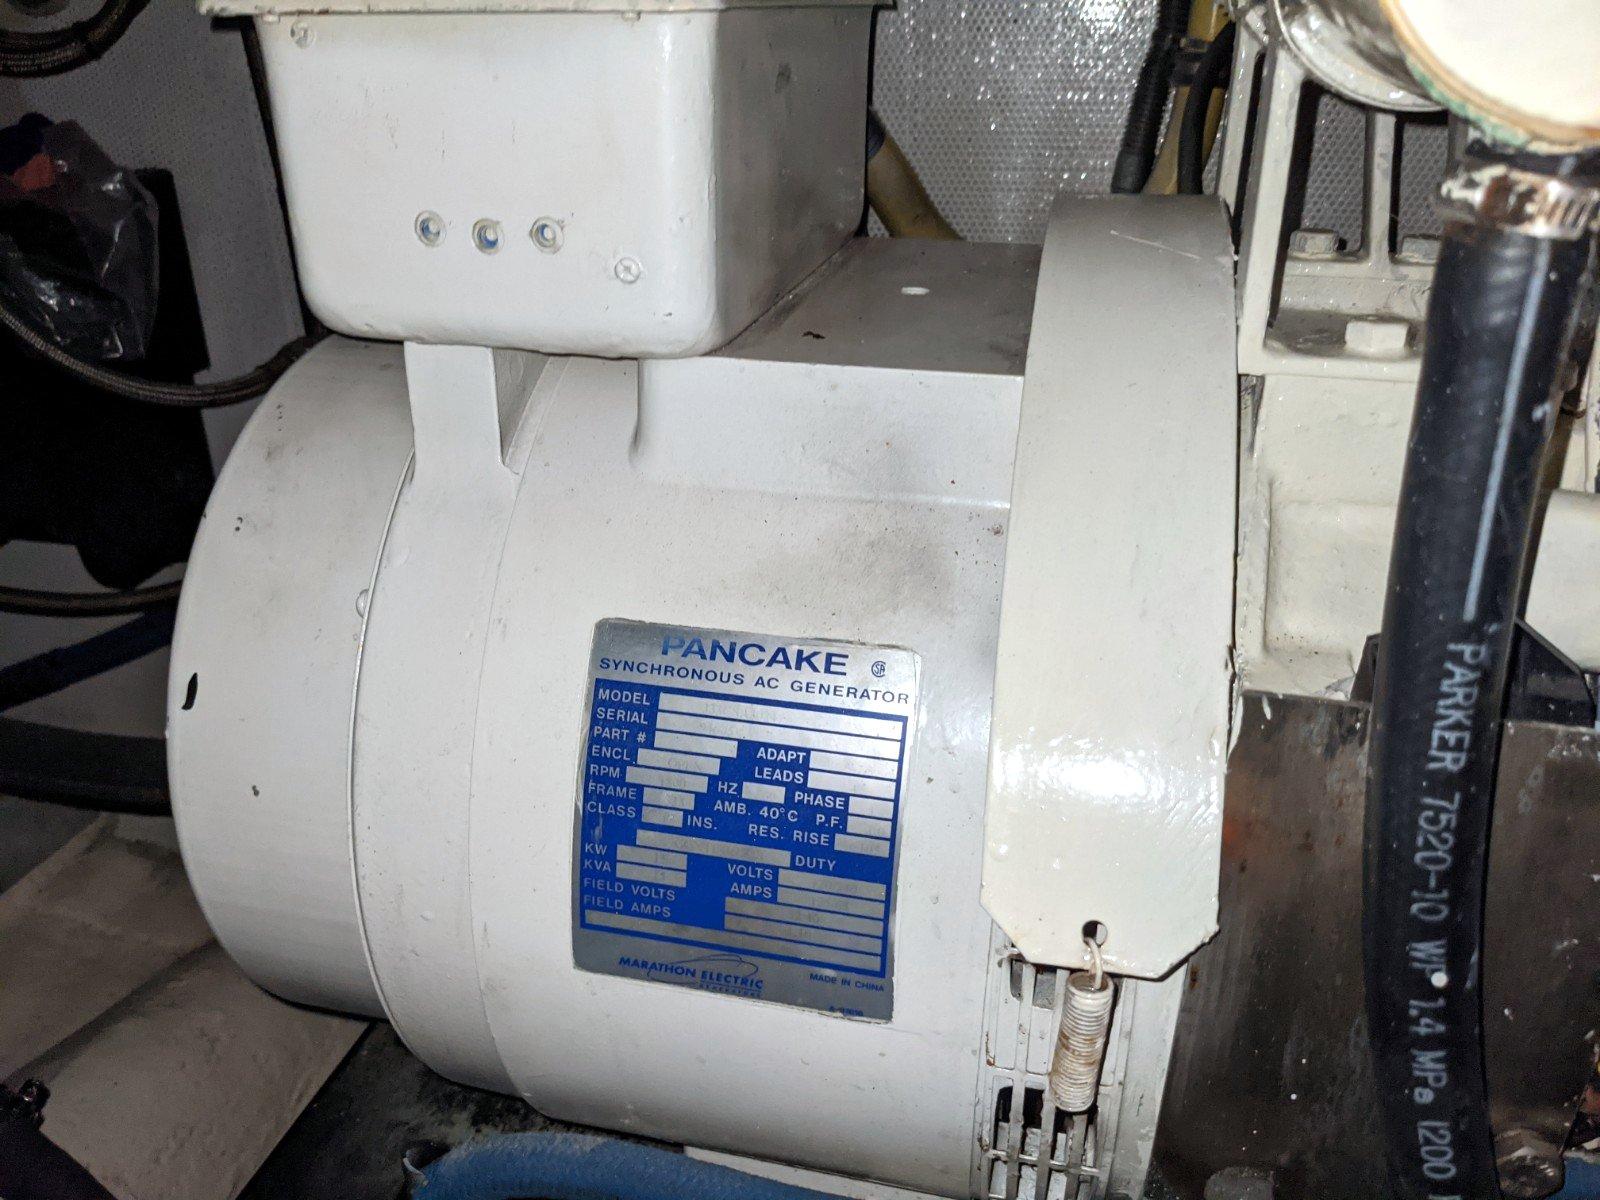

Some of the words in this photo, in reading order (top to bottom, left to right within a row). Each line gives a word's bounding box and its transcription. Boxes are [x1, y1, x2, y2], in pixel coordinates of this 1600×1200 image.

[661, 636, 849, 676] PANCAKE
[600, 658, 744, 685] SYNCHRONOUS
[754, 677, 779, 689] AC
[791, 680, 909, 704] GENERATOR
[598, 689, 650, 705] MODEL
[1426, 639, 1487, 773] PARKER
[596, 708, 648, 724] SERIAL
[594, 727, 630, 741] PART
[637, 732, 646, 743] #
[592, 746, 630, 760] ENCL
[756, 747, 806, 763] ADAPT
[590, 765, 620, 778] RPM
[754, 768, 804, 783] LEADS
[588, 782, 636, 798] FRAME
[718, 782, 738, 794] HZ
[795, 793, 845, 810] PHASE
[587, 802, 636, 817] CLASS
[687, 817, 717, 830] INS.
[748, 824, 783, 840] RES.
[793, 831, 829, 846] RISE
[585, 843, 607, 855] KW
[795, 856, 835, 871] DUTY
[1408, 792, 1462, 923] 7520-10
[584, 860, 611, 872] KVA
[728, 865, 773, 880] VOLTS
[584, 879, 624, 893] FIELD
[631, 885, 675, 900] VOLTS
[730, 883, 772, 898] AMPS
[584, 895, 624, 910] FIELD
[631, 903, 671, 917] AMPS
[619, 956, 695, 978] MARATHON
[701, 971, 763, 990] ELECTRIC
[810, 973, 837, 984] MADE
[841, 978, 850, 986] IN
[855, 980, 884, 992] CHINA
[1417, 1120, 1457, 1179] 1200
